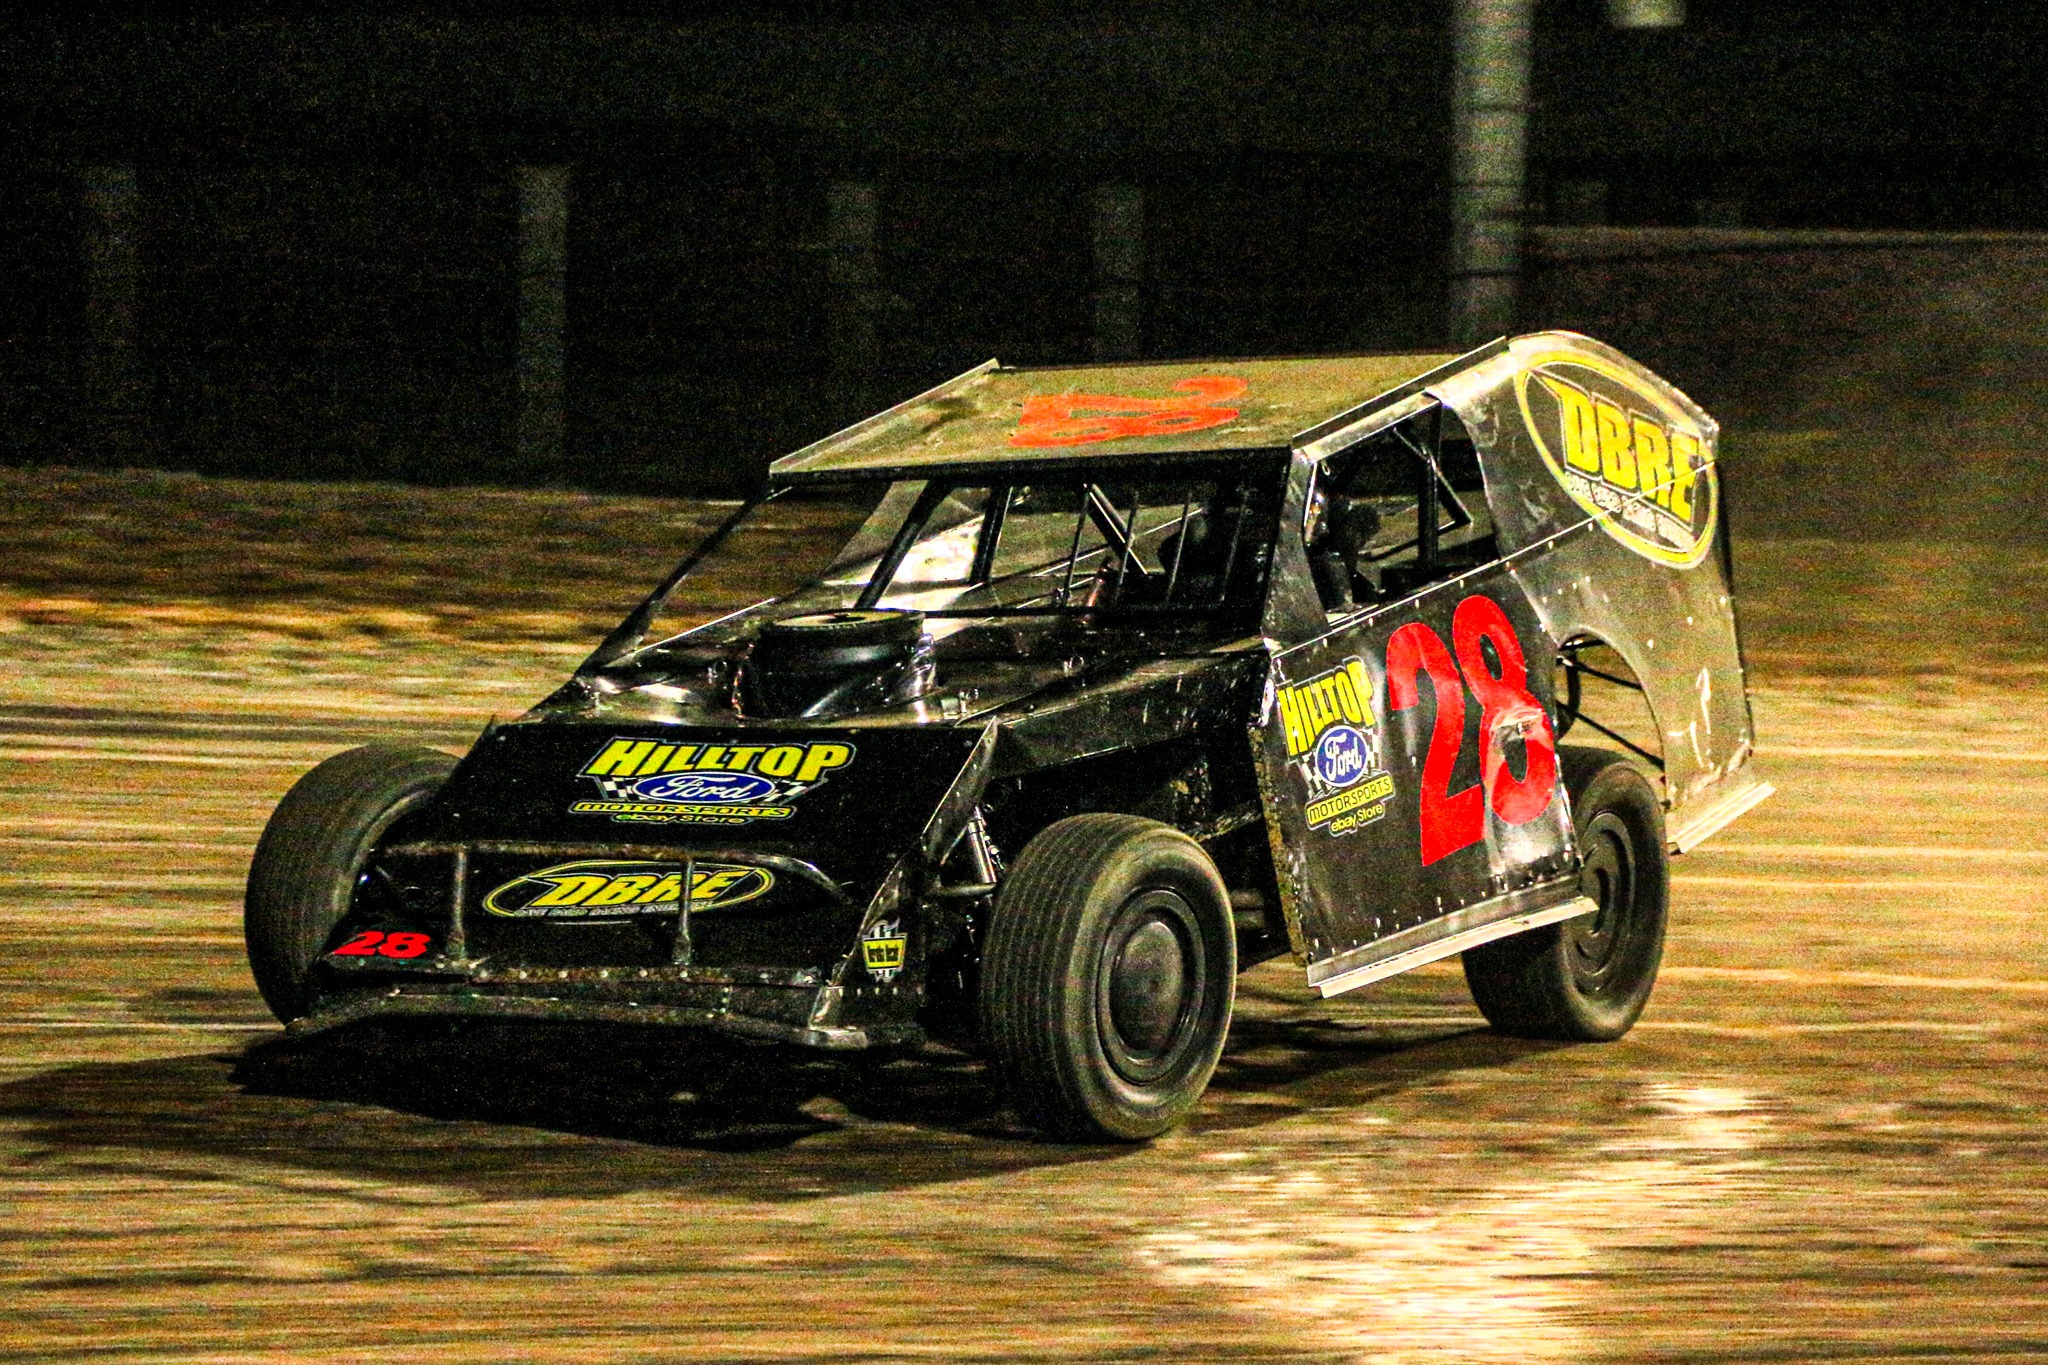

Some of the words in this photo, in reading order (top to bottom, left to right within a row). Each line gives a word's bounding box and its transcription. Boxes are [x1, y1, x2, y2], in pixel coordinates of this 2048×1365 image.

[1542, 376, 1701, 524] DBRE
[1277, 661, 1376, 757] HILLTOP
[1386, 595, 1556, 867] 28
[584, 739, 850, 781] HILLTOP
[1325, 731, 1362, 781] Ford
[649, 775, 752, 800] Ford
[1308, 778, 1391, 821] MOTORSPORTS
[578, 802, 791, 816] MOTORSPORTS
[615, 813, 677, 823] ebay
[680, 815, 746, 824] Store
[1330, 815, 1357, 832] ebay
[1357, 803, 1383, 822] Store
[333, 931, 431, 959] 28
